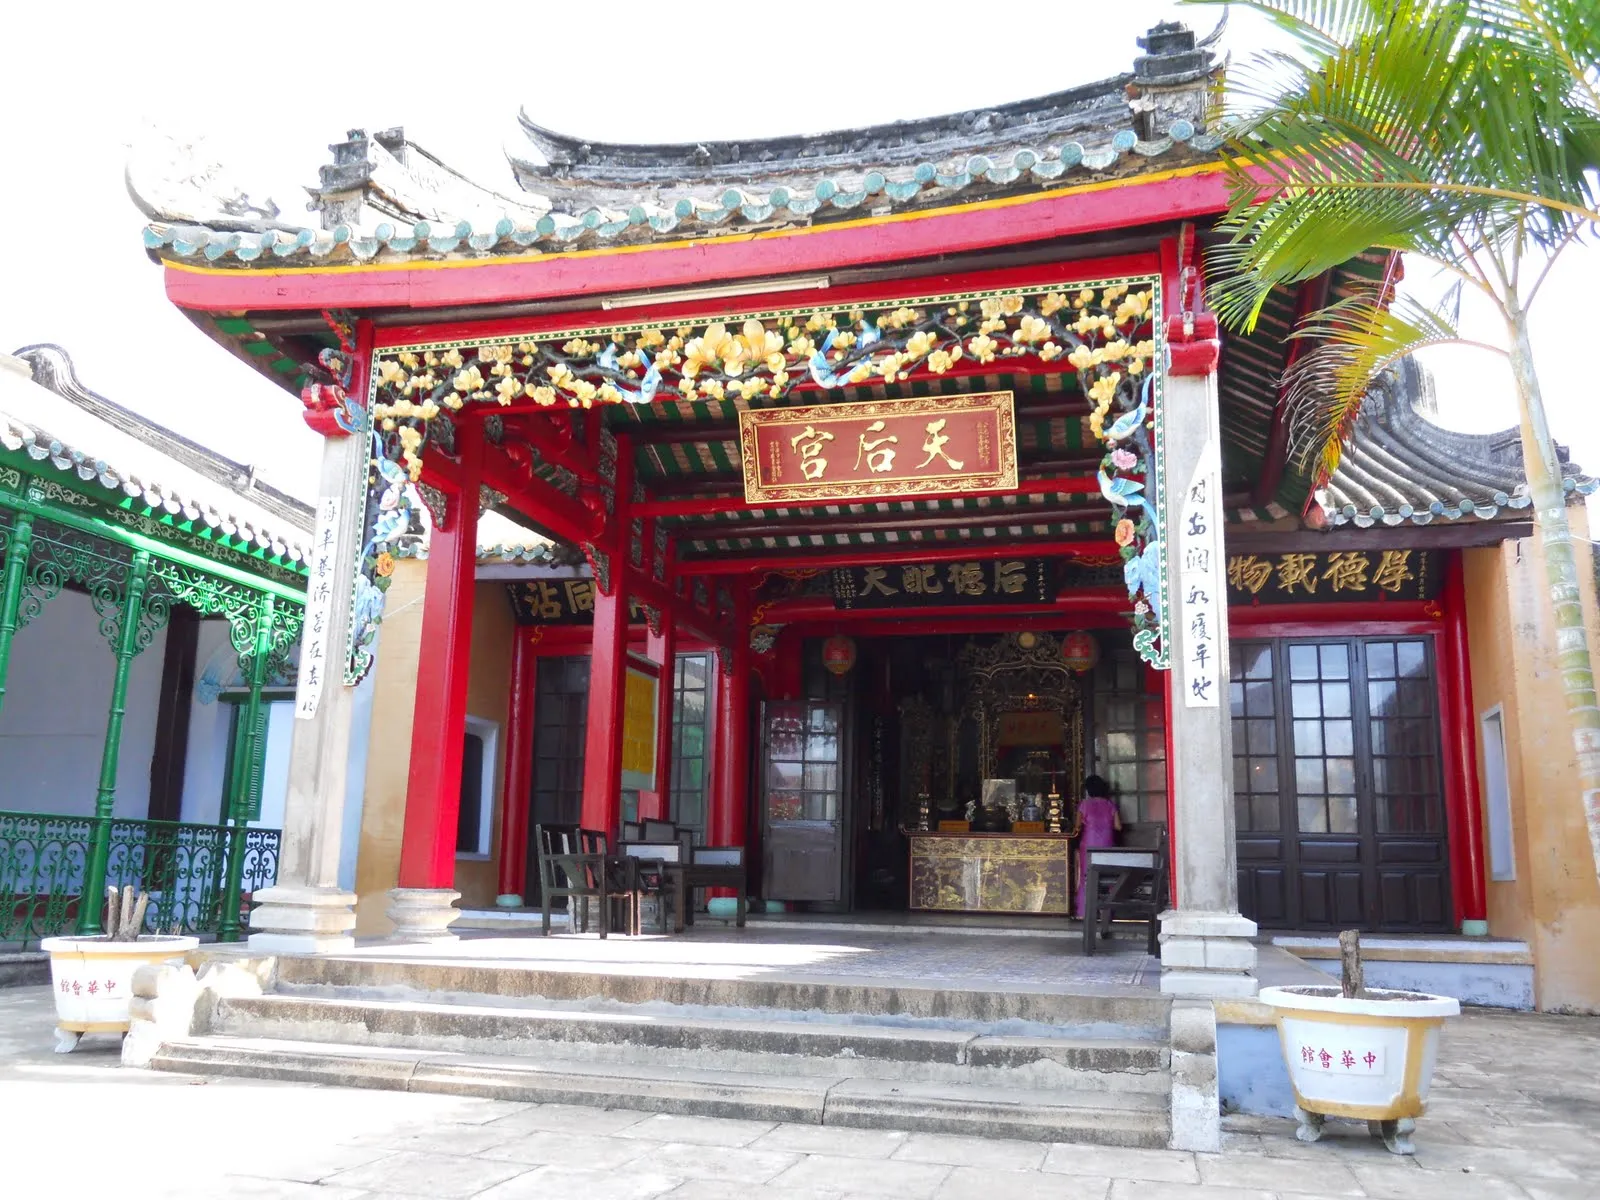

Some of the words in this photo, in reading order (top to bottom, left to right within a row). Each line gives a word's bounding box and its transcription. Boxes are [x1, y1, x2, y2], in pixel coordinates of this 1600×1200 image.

[791, 418, 964, 480] 天后宮
[1301, 1046, 1377, 1069] 中華會館
